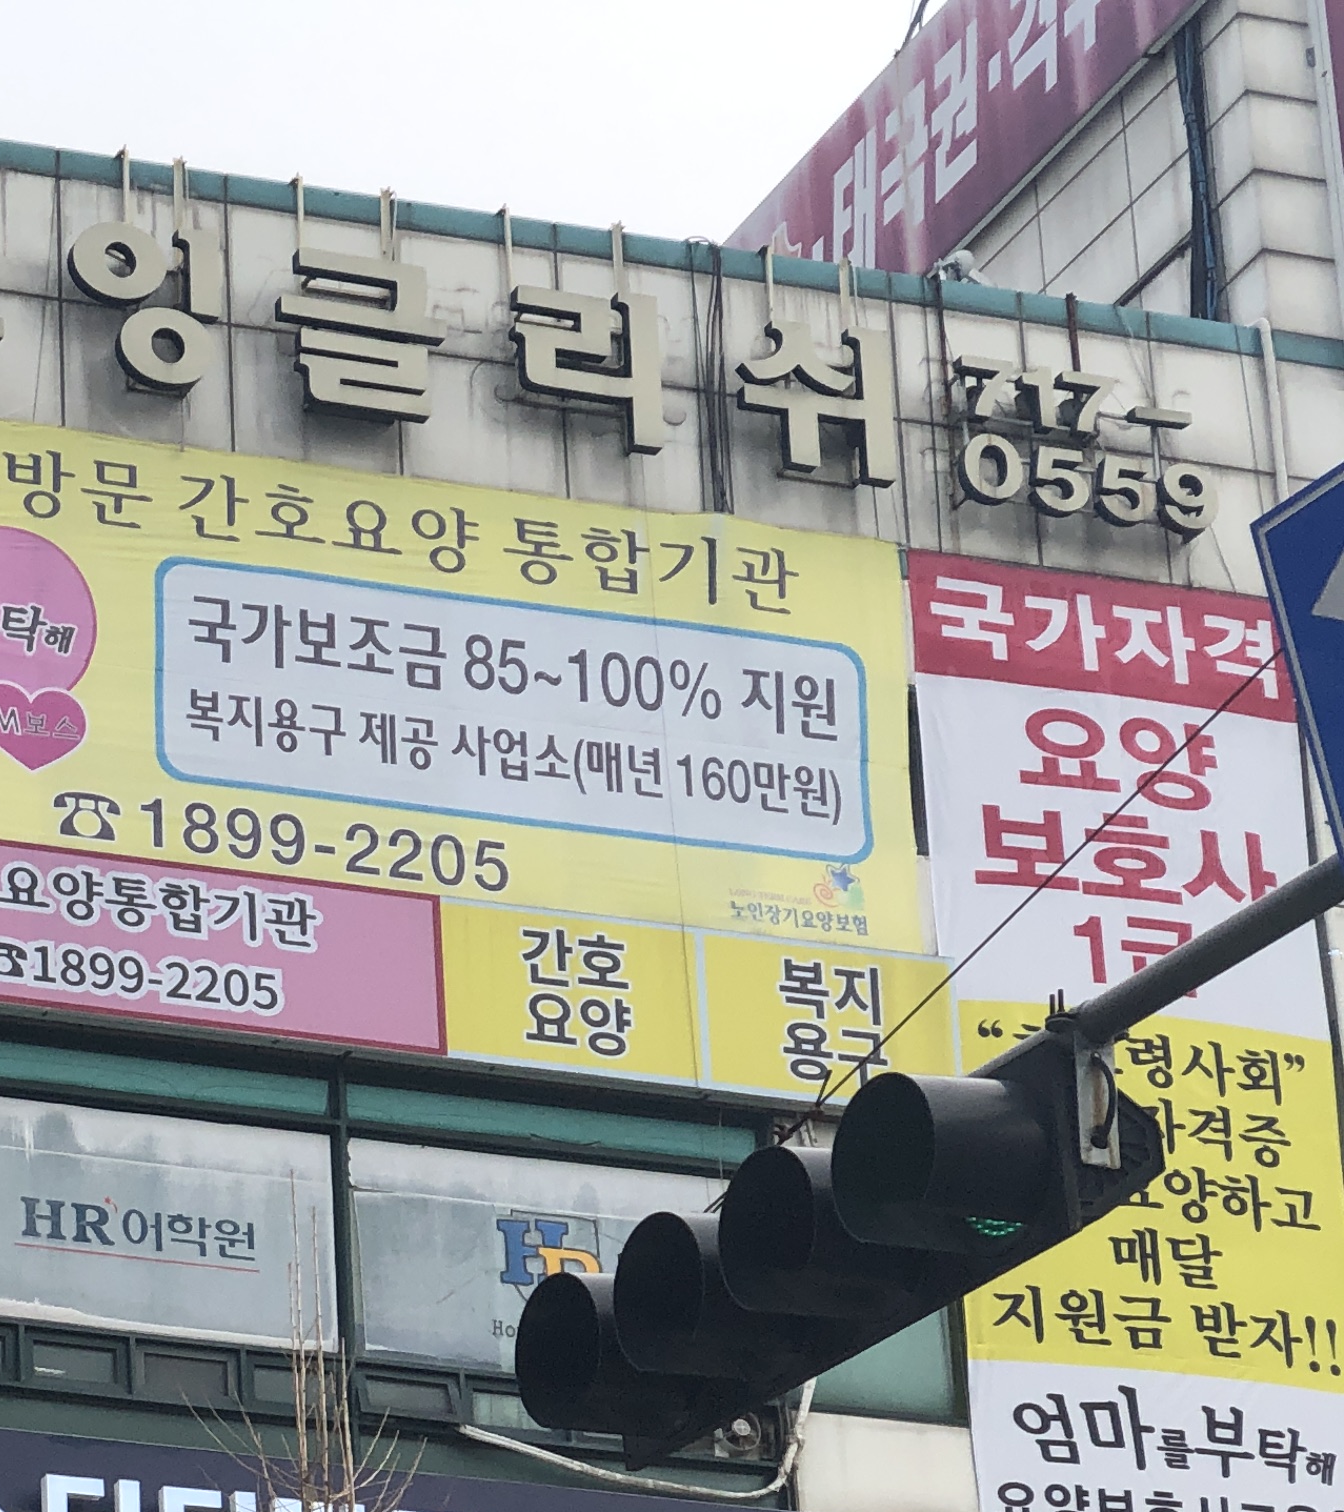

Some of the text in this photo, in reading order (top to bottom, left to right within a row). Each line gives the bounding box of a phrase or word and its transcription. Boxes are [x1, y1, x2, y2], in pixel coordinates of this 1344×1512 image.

[953, 354, 1192, 441] 717-
[955, 431, 1217, 541] 0559
[179, 473, 480, 575] 간호요양
[503, 514, 800, 617] 통합기관
[186, 594, 839, 744] 국가보조금 85~100% 지원
[930, 576, 1280, 699] 국가자격
[185, 687, 845, 826] 복지용구 제공 사업소(매년 160만원)
[1020, 707, 1219, 812] 요양
[144, 797, 510, 893] 1899-2205
[974, 803, 1278, 906] 보호사
[521, 926, 632, 993] 간호
[730, 900, 869, 937] 노인장기요양보험
[32, 945, 281, 1013] 1899-2205
[778, 957, 883, 1027] 복지
[523, 995, 634, 1058] 요양
[781, 1025, 890, 1083] 용구
[1108, 1228, 1224, 1290] 매달
[993, 1286, 1342, 1376] 지원금 받자!!
[1012, 1384, 1337, 1487] 엄마를부탁해
